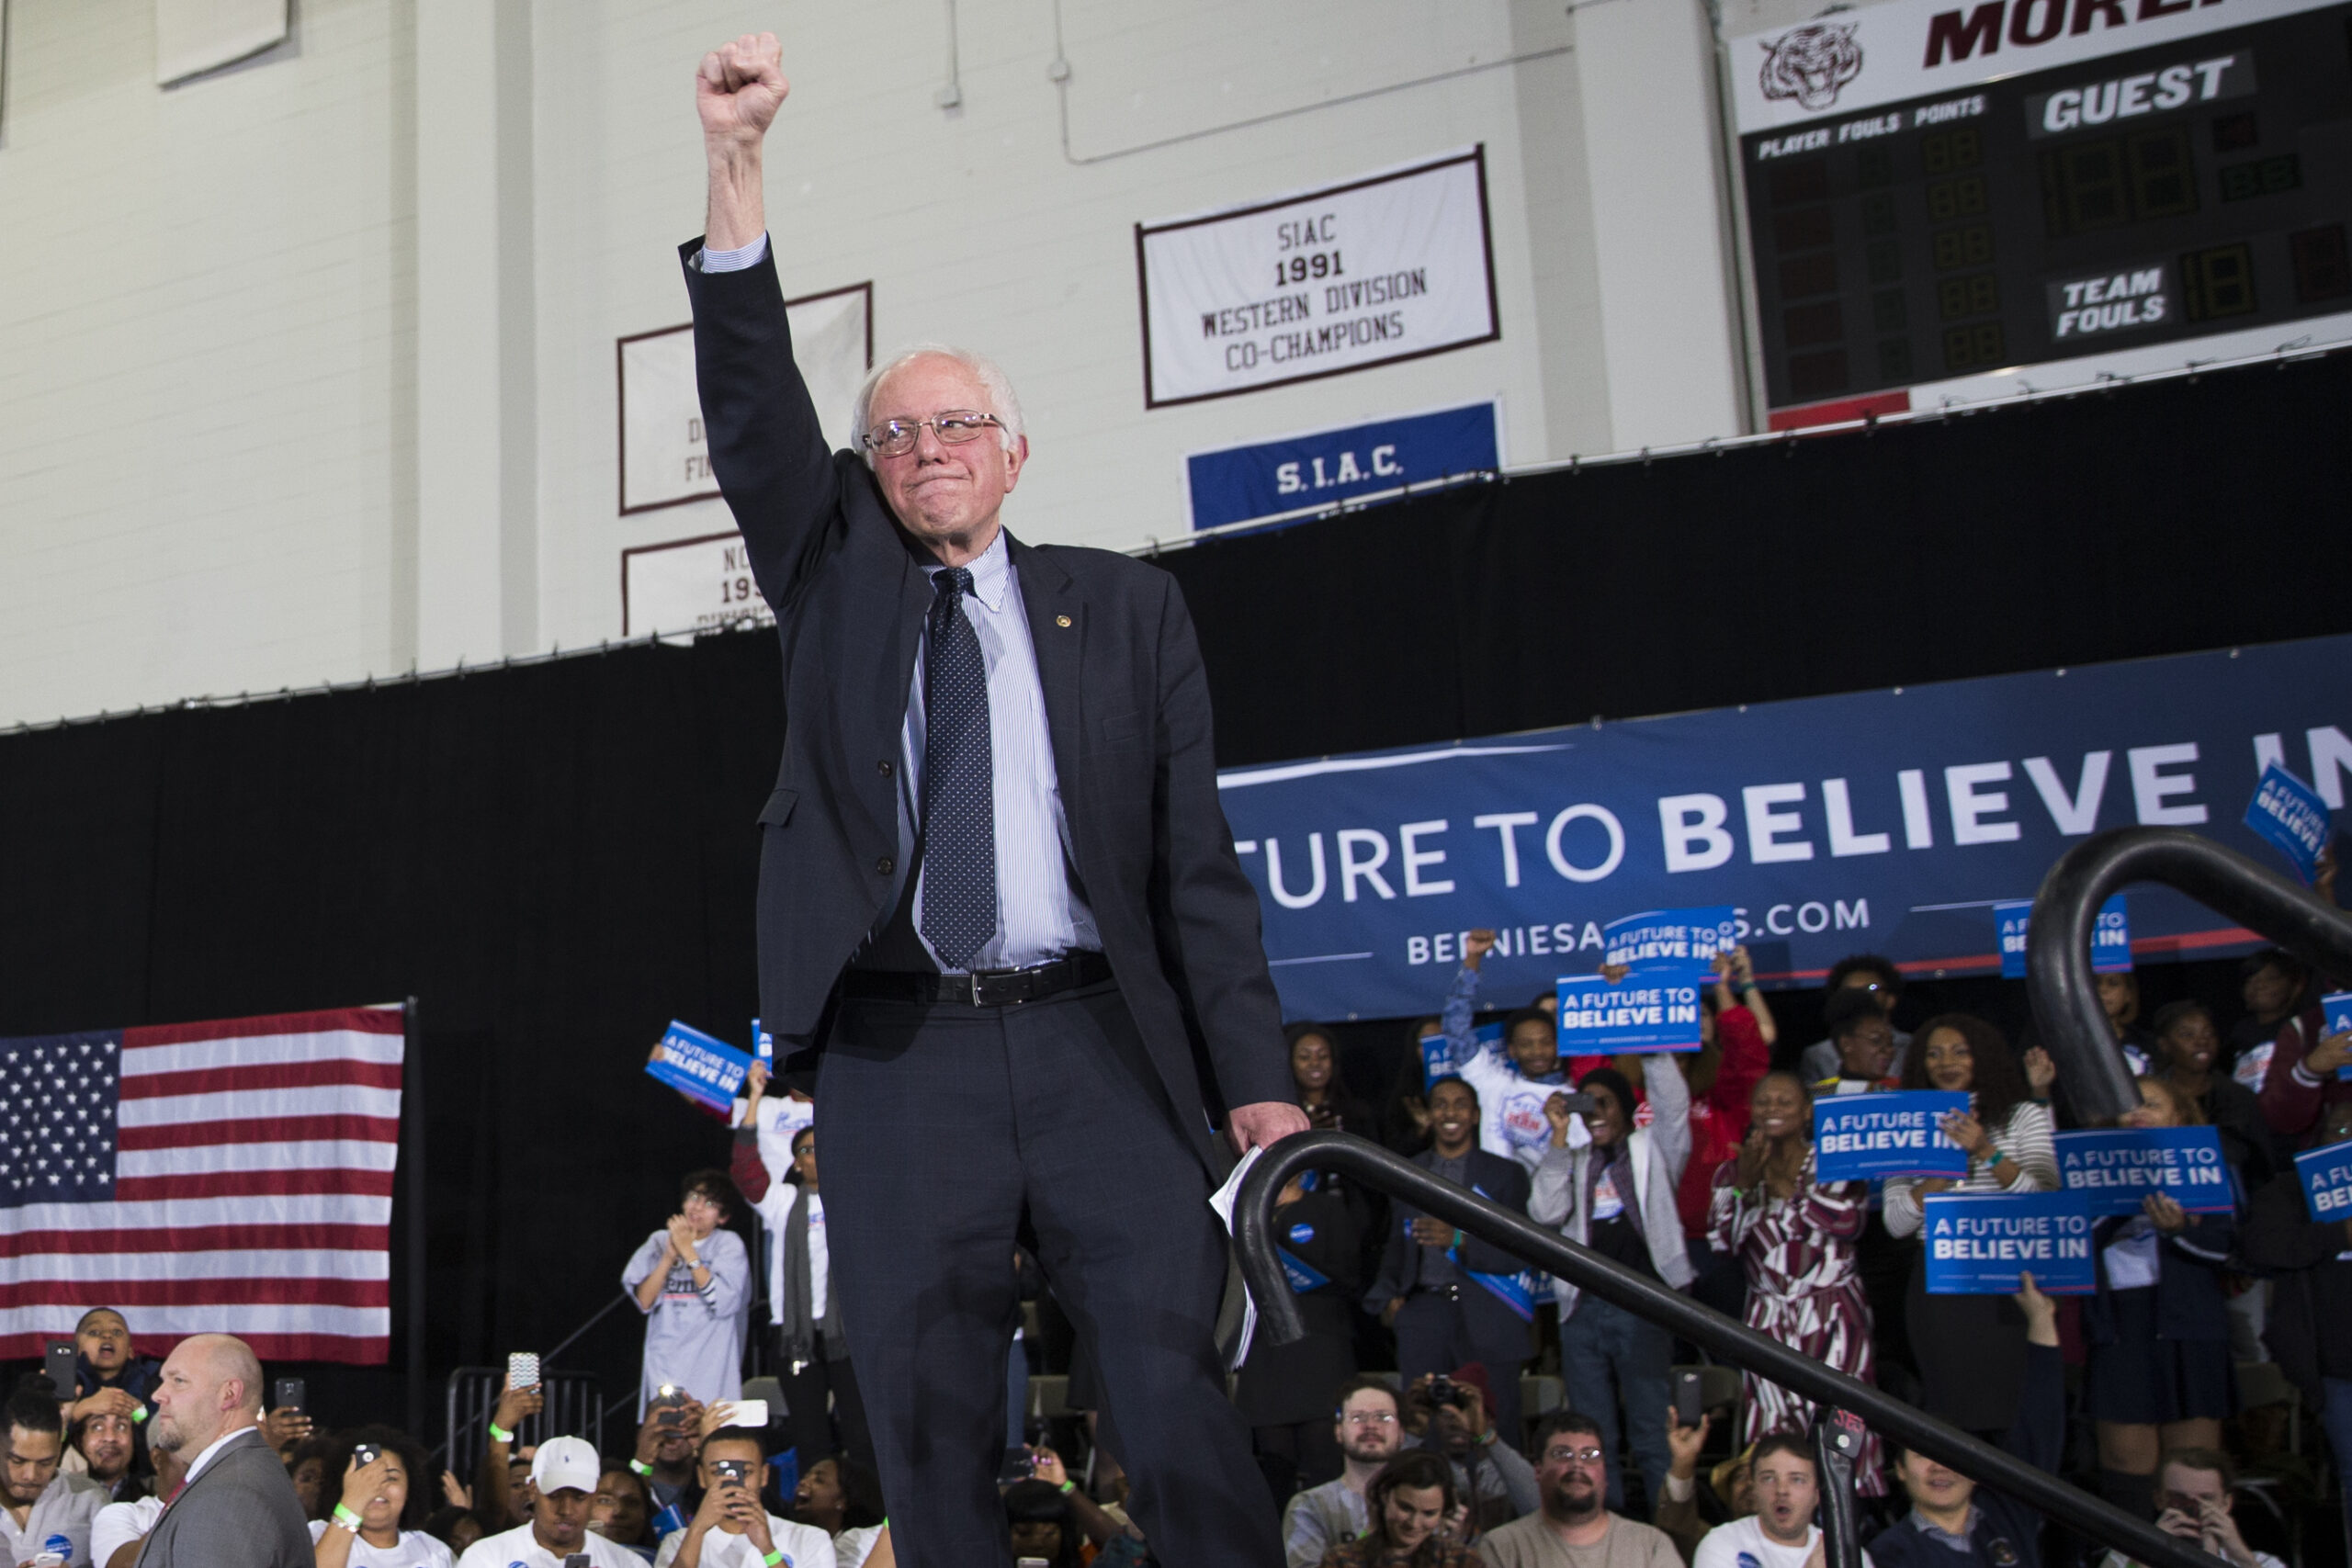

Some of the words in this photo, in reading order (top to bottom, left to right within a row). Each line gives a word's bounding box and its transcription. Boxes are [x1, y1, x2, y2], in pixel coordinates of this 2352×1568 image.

[2042, 55, 2235, 132] GUEST
[1758, 129, 1830, 160] PLAYER
[1838, 112, 1901, 143] FOULS
[1914, 95, 1985, 127] POINTS
[1277, 214, 1336, 251] SIAC
[1276, 250, 1343, 287] 1991
[2063, 267, 2163, 309] TEAM
[1201, 293, 1310, 340] WESTERN
[1325, 267, 1427, 314] DIVISION
[2056, 295, 2165, 337] FOULS
[1225, 310, 1404, 371] CO-CHAMPIONS
[1276, 446, 1403, 494] S.I.A.C.
[1474, 804, 1625, 888] TO
[1658, 742, 2208, 874] BELIEVE
[2257, 791, 2319, 852] BELIEVE
[2002, 919, 2016, 934] A
[2097, 912, 2125, 929] TO
[1608, 936, 1619, 950] A
[1619, 926, 1688, 946] FUTURE
[1690, 927, 1718, 943] TO
[2098, 928, 2127, 947] IN
[1606, 942, 1689, 966] BELIEVE
[1692, 943, 1717, 960] IN
[1564, 994, 1579, 1010] A
[1582, 988, 1662, 1009] FUTURE
[1665, 987, 1696, 1004] TO
[1563, 1006, 1663, 1029] BELIEVE
[1668, 1005, 1696, 1024] IN
[666, 1035, 677, 1047] A
[677, 1039, 726, 1067] FUTURE
[724, 1061, 745, 1079] TO
[718, 1076, 740, 1093] IN
[1821, 1117, 1837, 1133] A
[1840, 1111, 1926, 1131] FUTURE
[1821, 1130, 1927, 1154] BELIEVE
[2064, 1152, 2081, 1168] A
[2085, 1148, 2177, 1167] FUTURE
[2180, 1147, 2217, 1164] TO
[2066, 1168, 2183, 1189] BELIEVE
[2188, 1167, 2222, 1185] IN
[2312, 1173, 2327, 1190] A
[1934, 1218, 1951, 1235] A
[1956, 1216, 2051, 1235] FUTURE
[2053, 1215, 2086, 1234] TO
[1934, 1239, 2052, 1259] BELIEVE
[2058, 1238, 2087, 1258] IN
